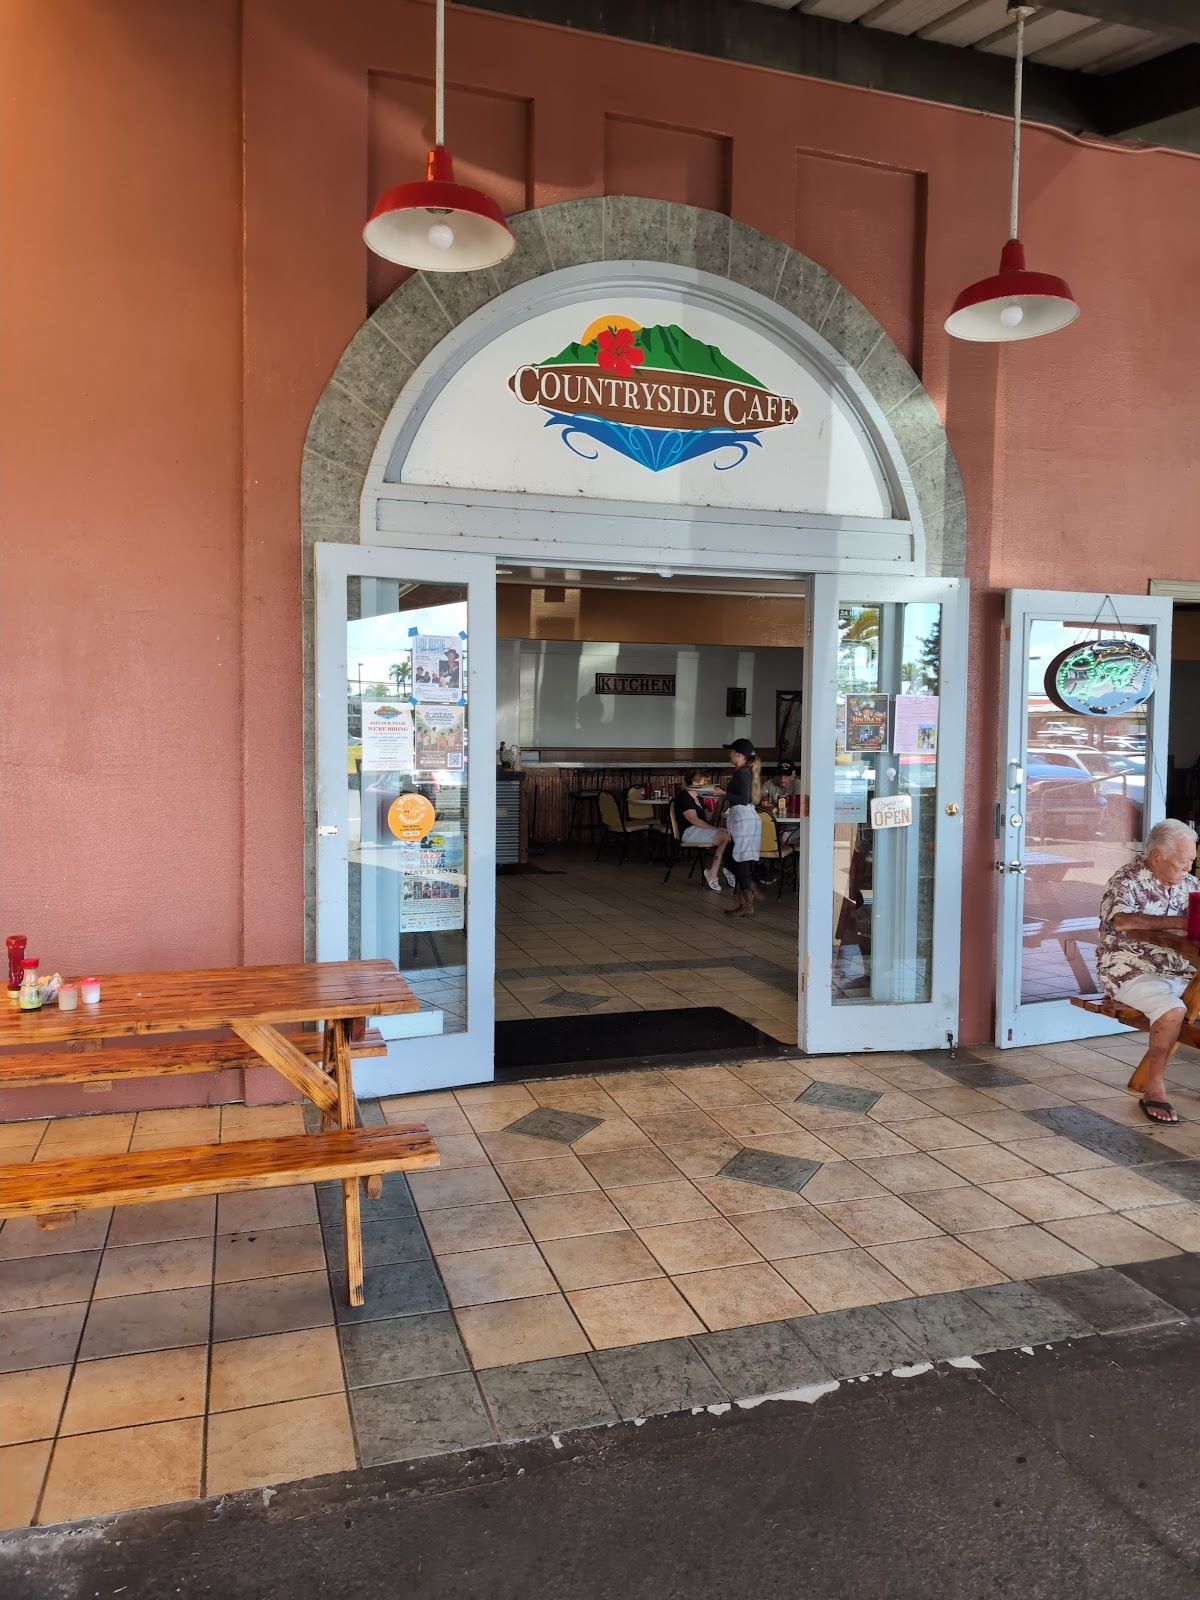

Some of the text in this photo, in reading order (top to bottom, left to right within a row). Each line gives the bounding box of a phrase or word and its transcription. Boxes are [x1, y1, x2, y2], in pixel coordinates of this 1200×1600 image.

[514, 365, 796, 425] COUNTRYSIDE CAFE
[600, 677, 672, 692] KITCHEN
[874, 808, 910, 827] OPEN
